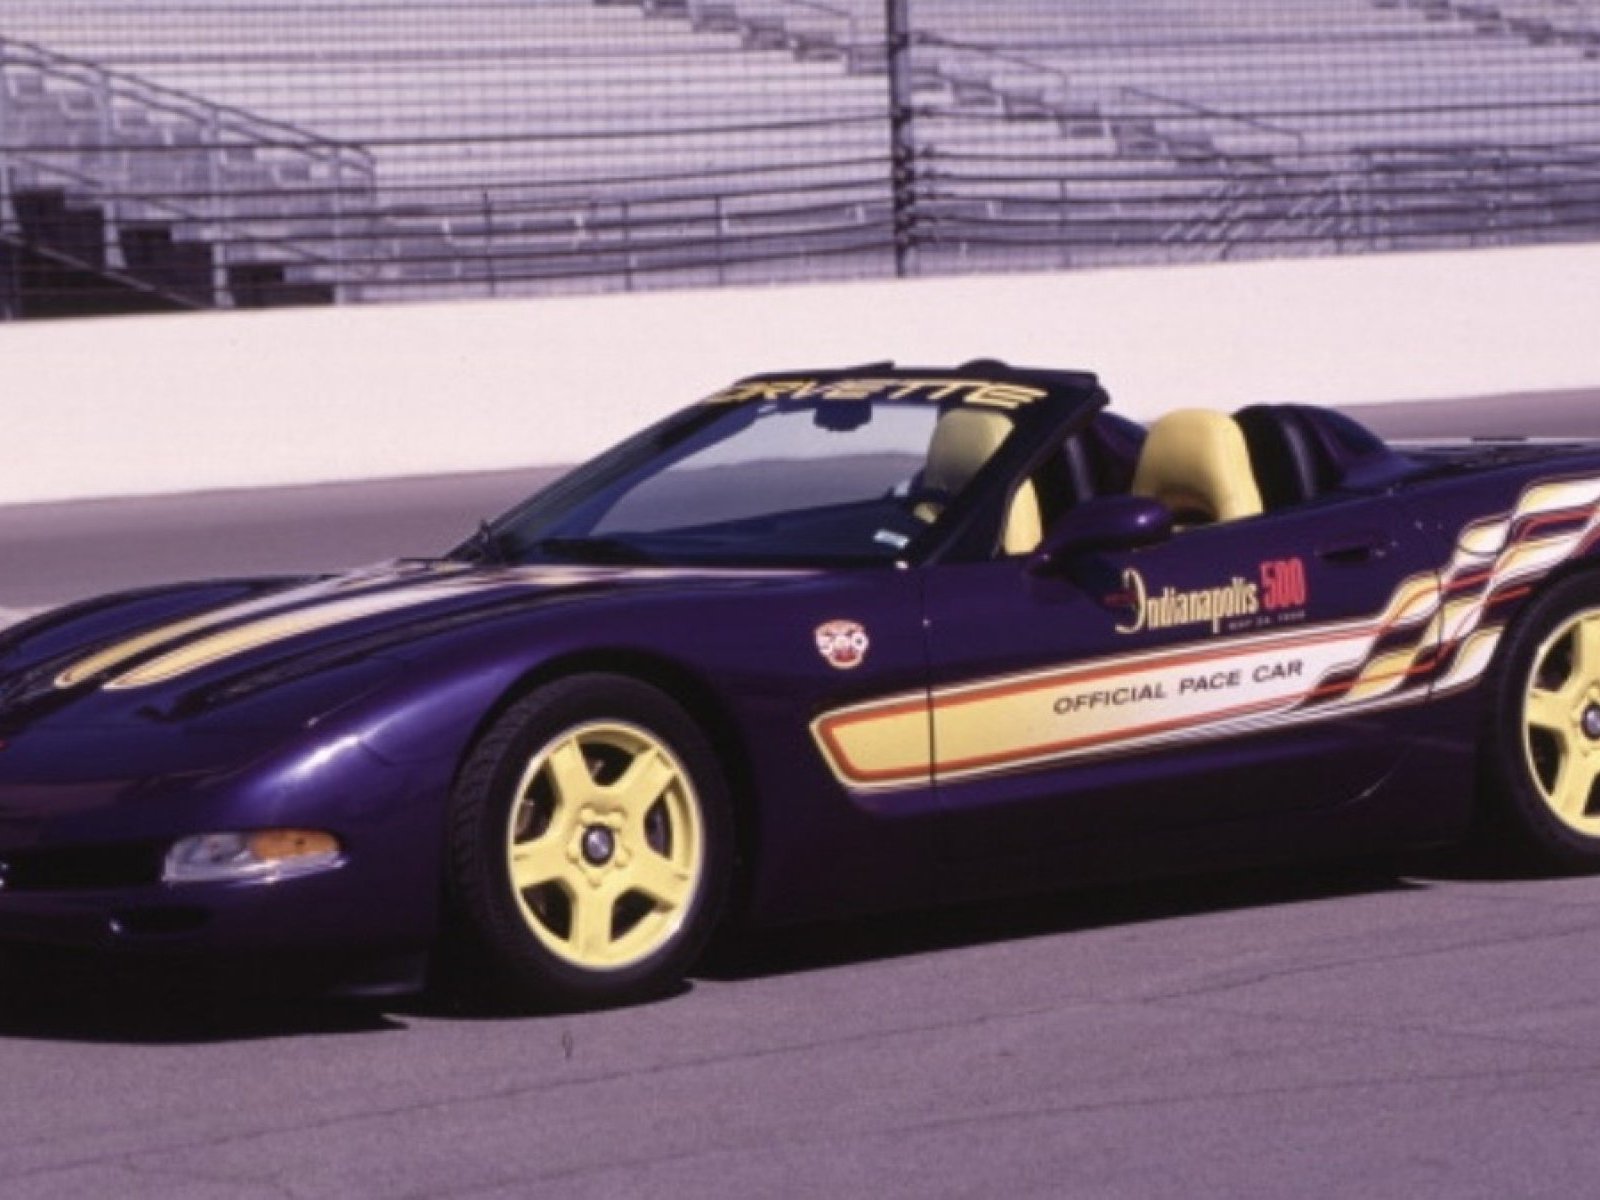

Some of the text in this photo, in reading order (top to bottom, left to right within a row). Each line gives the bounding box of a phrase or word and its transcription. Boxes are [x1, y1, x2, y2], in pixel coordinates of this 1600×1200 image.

[1115, 558, 1306, 633] Indianapolis 500
[1053, 659, 1304, 714] OFFICIAL PACE CAR
